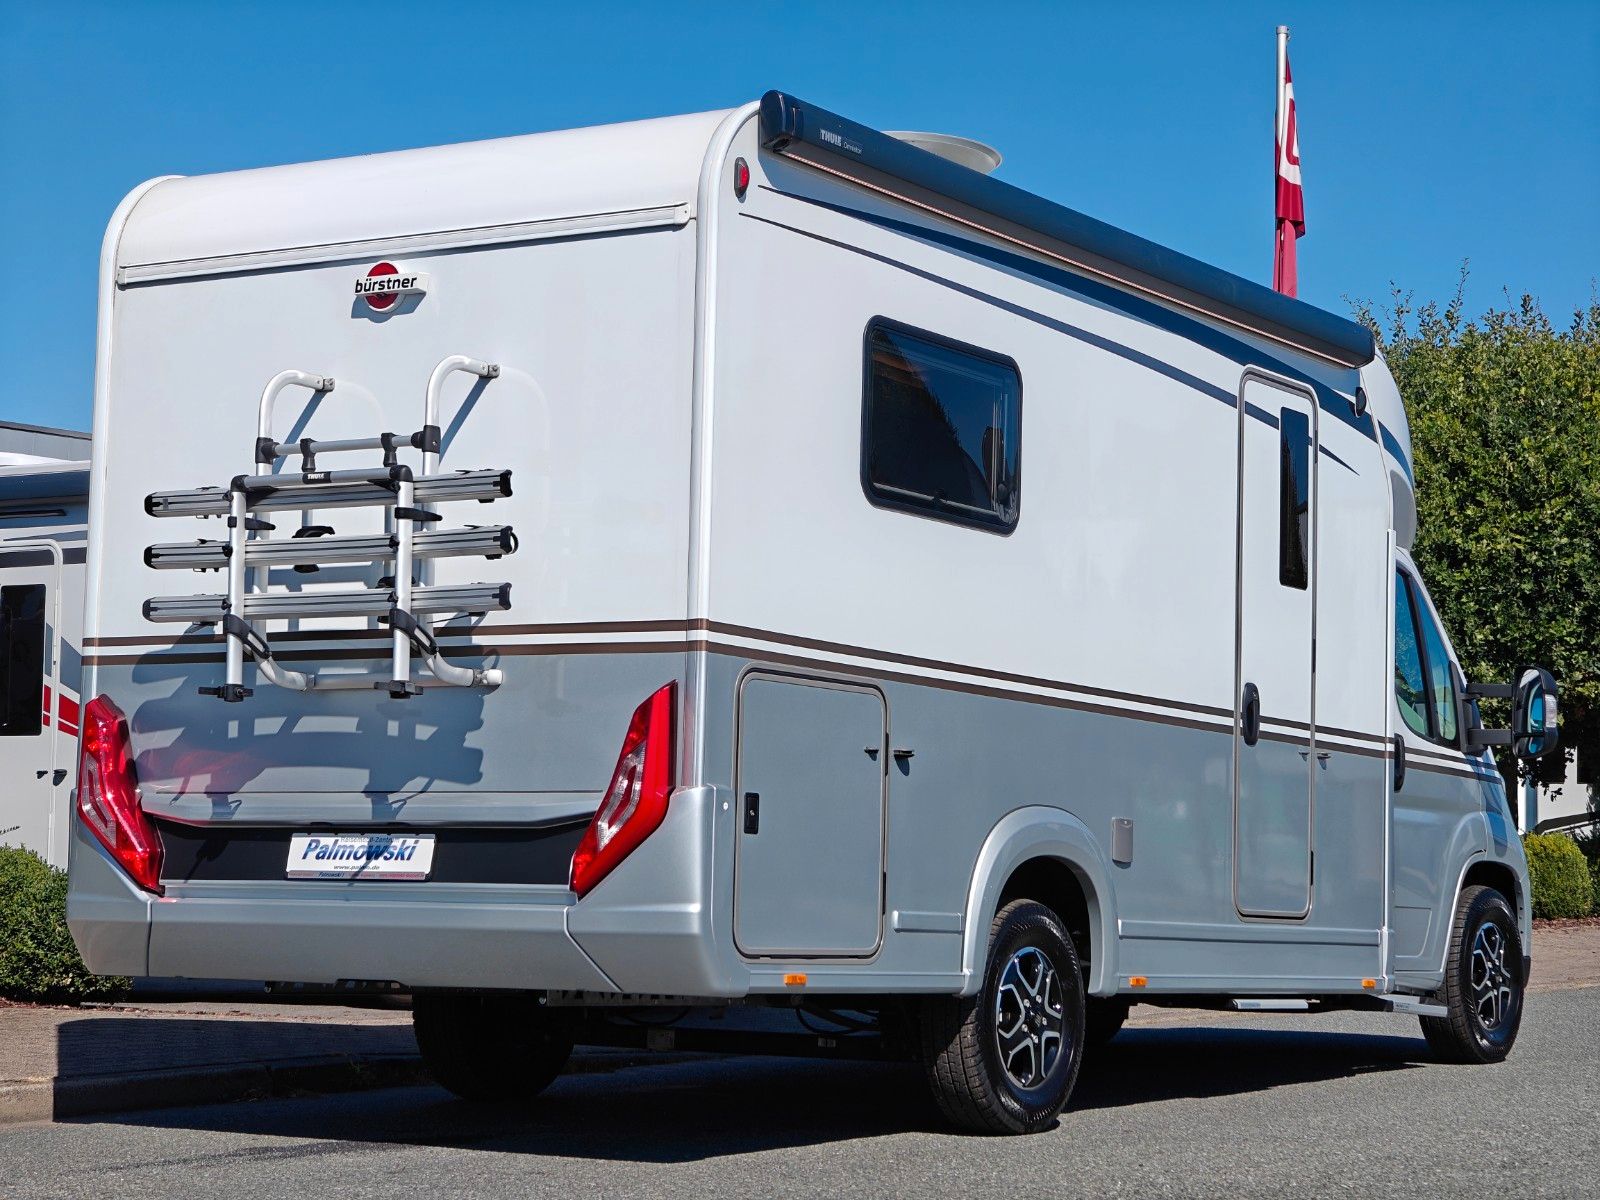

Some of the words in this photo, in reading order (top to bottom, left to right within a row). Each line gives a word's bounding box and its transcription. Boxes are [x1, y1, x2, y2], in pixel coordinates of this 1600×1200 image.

[820, 129, 842, 147] THULE
[355, 277, 417, 293] bürstner
[302, 839, 420, 861] Palmowski
